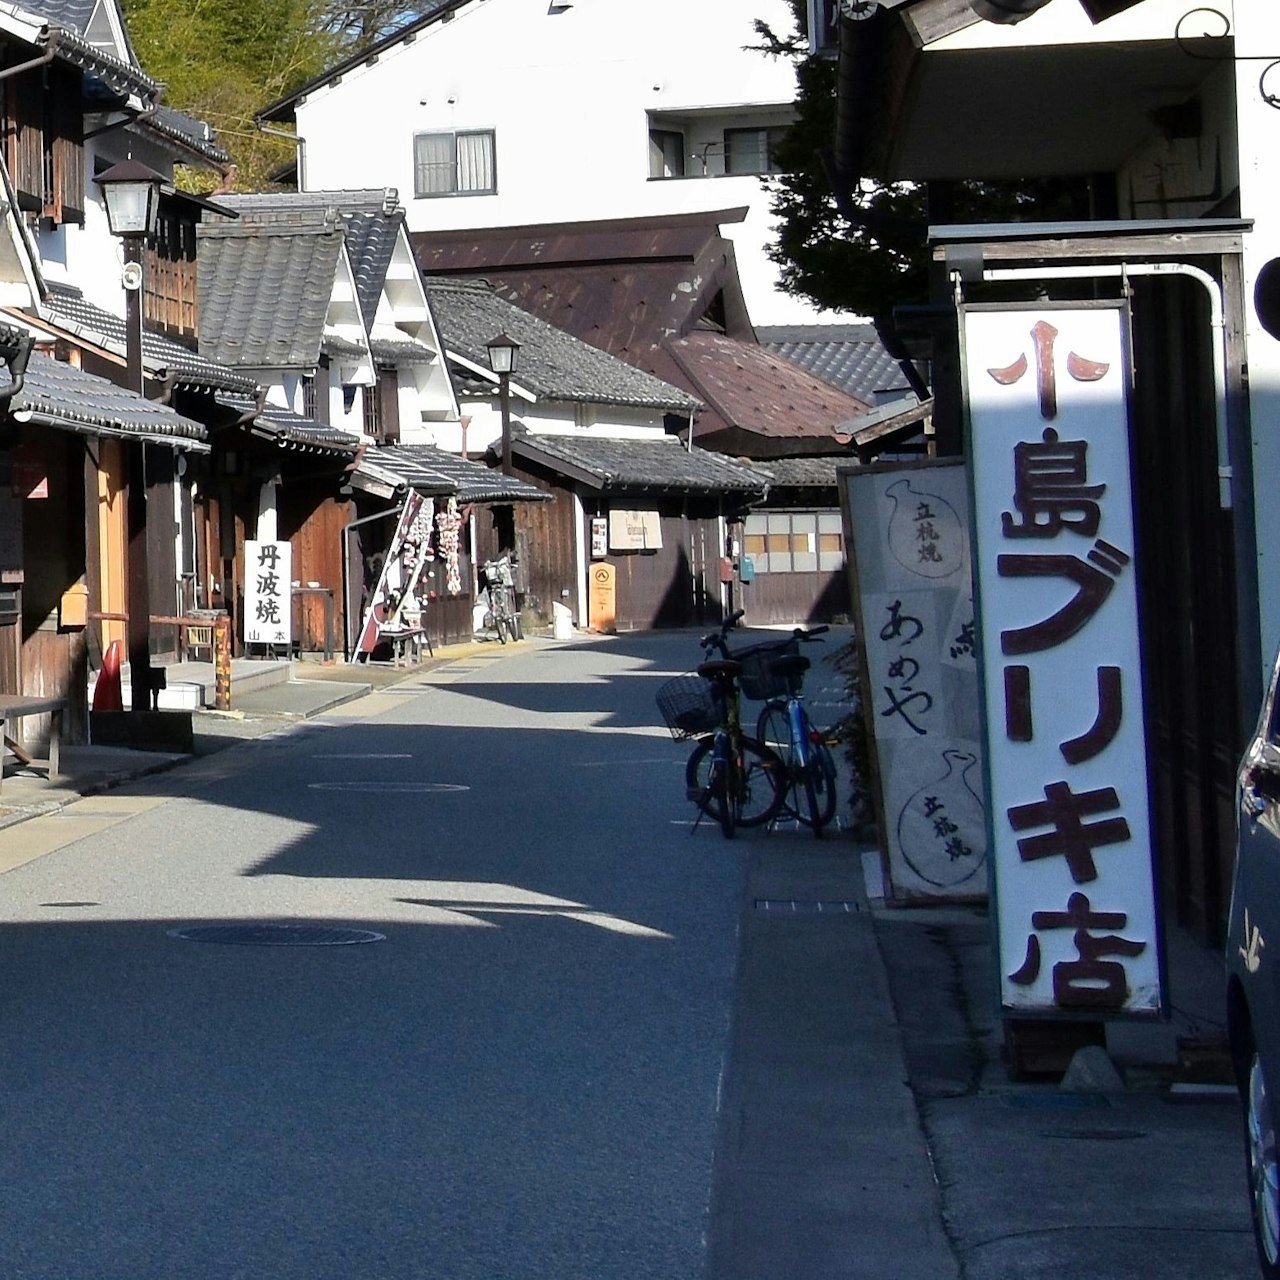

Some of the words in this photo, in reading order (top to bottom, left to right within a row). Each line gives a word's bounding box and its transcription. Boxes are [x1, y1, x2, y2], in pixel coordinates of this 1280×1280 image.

[255, 543, 281, 624] 丹波焼
[880, 601, 933, 736] あめや
[988, 320, 1148, 1008] 小島ブリキ店
